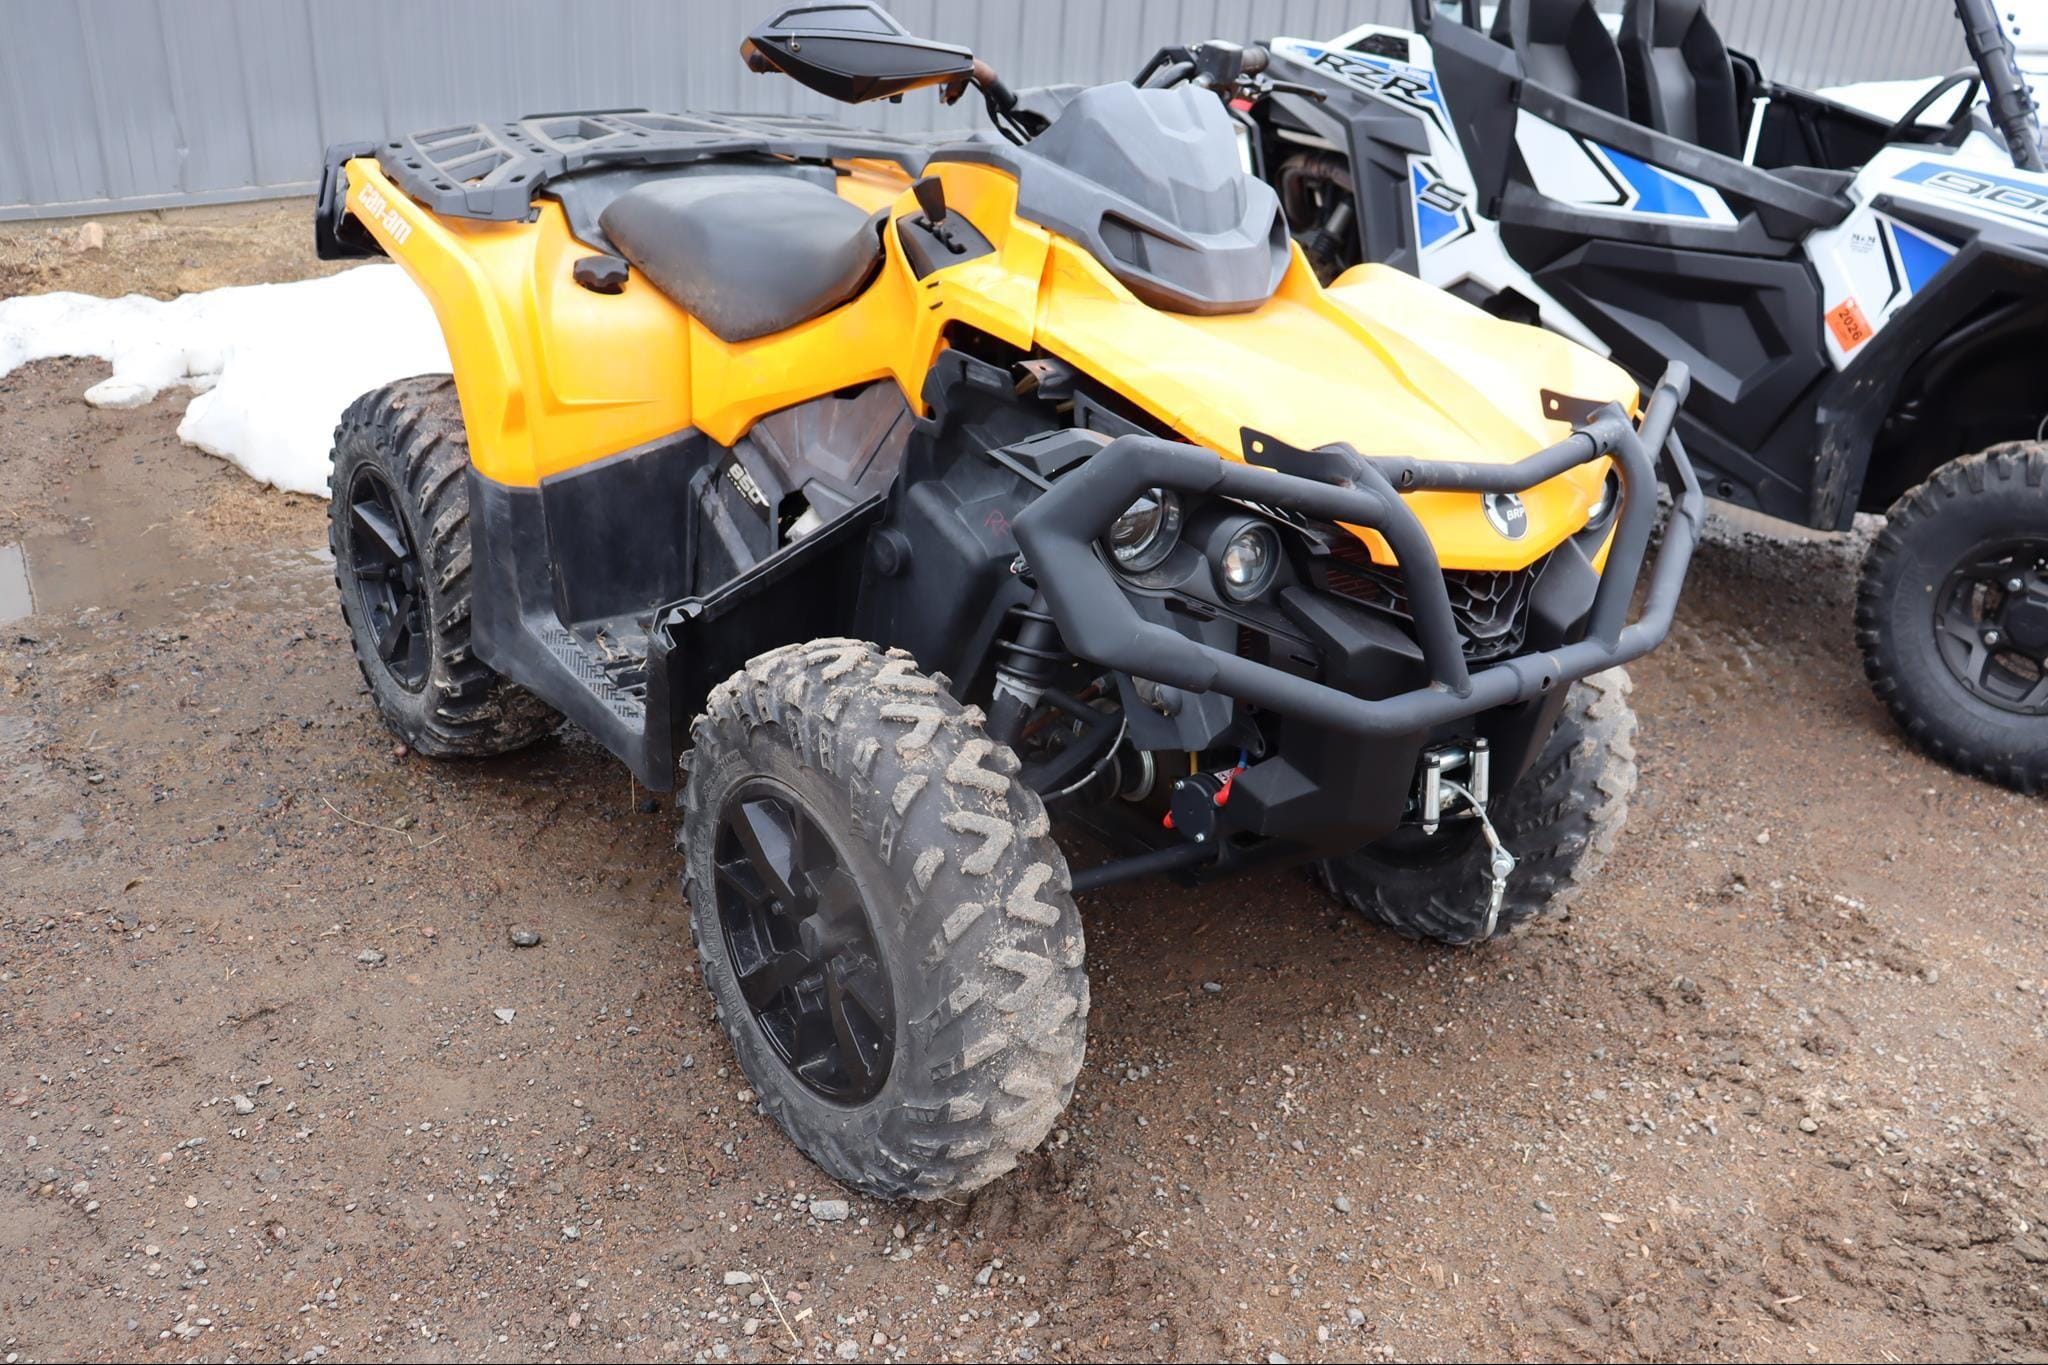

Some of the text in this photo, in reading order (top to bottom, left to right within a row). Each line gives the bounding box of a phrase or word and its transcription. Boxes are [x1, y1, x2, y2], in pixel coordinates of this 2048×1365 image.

[1314, 52, 1430, 100] RZR
[359, 183, 412, 245] can-am
[1418, 182, 1467, 213] S
[1926, 172, 2048, 216] 90
[1838, 308, 1863, 341] 2026
[728, 462, 763, 505] 850
[1506, 506, 1525, 521] BRP
